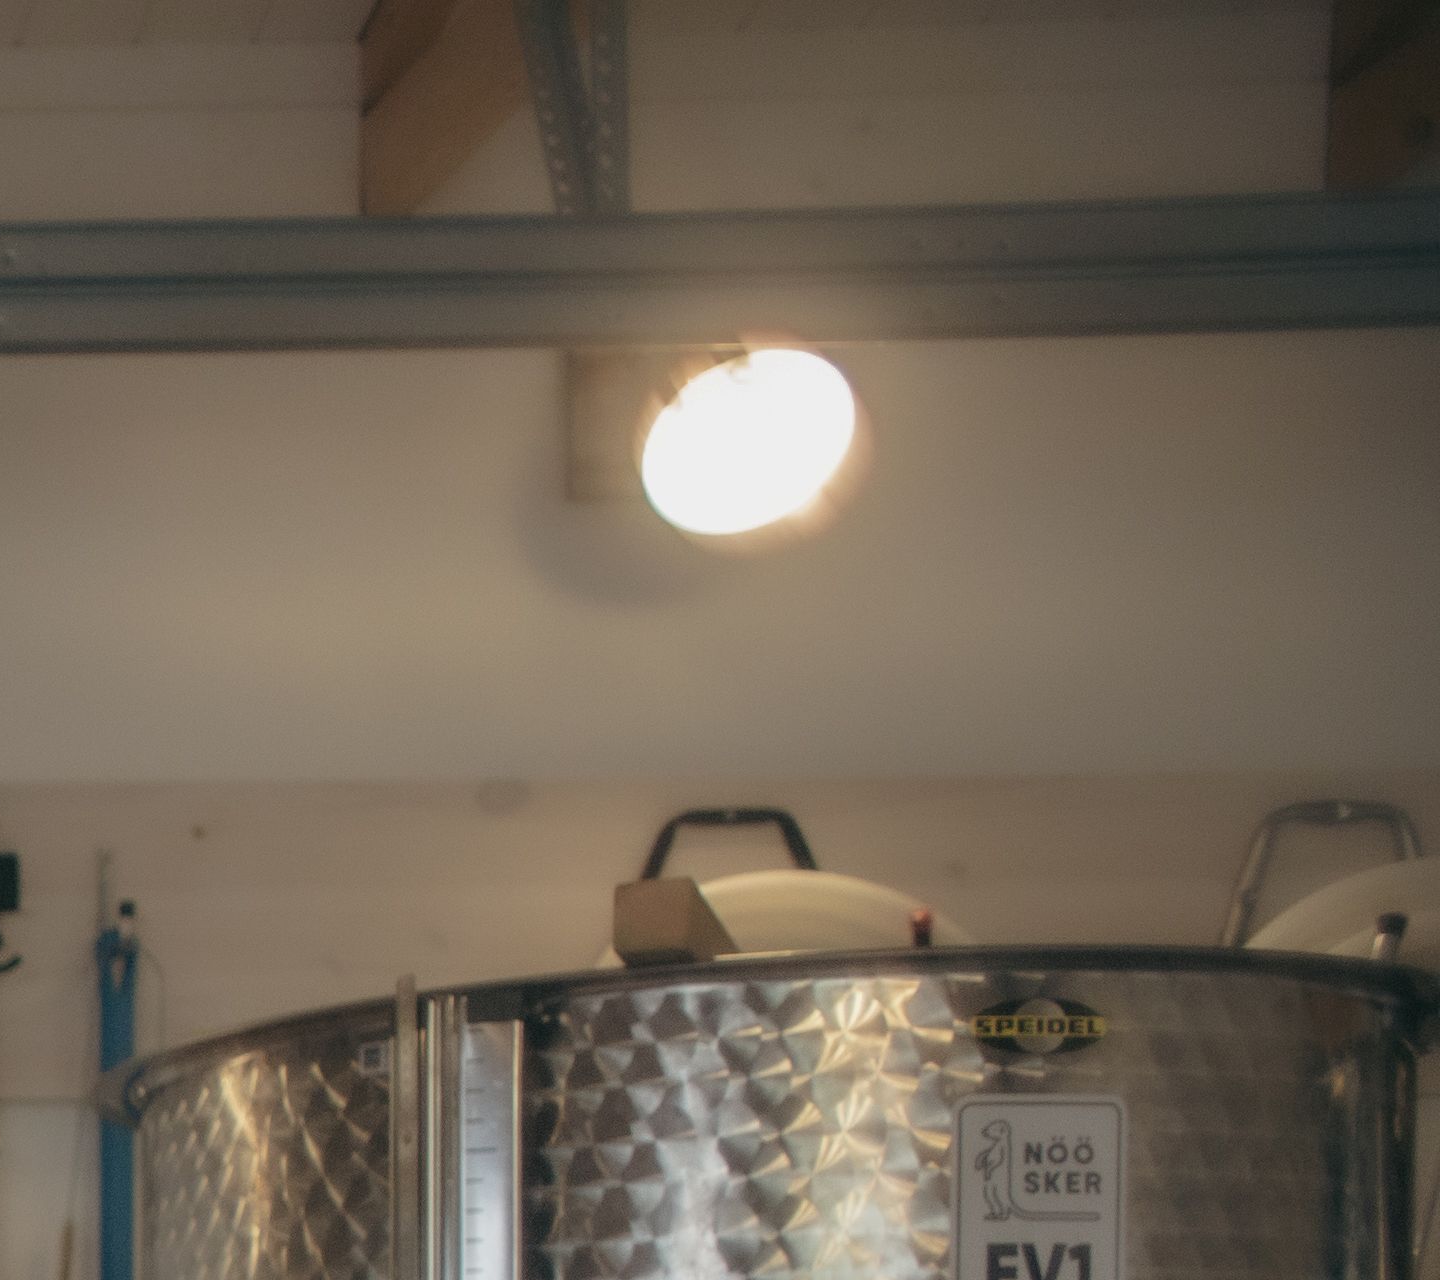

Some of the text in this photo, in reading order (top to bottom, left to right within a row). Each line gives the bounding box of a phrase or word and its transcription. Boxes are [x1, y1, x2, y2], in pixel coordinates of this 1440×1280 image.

[973, 1016, 1104, 1036] SPEIDEL
[1023, 1136, 1094, 1165] NÖÖ
[1023, 1171, 1102, 1195] SKER
